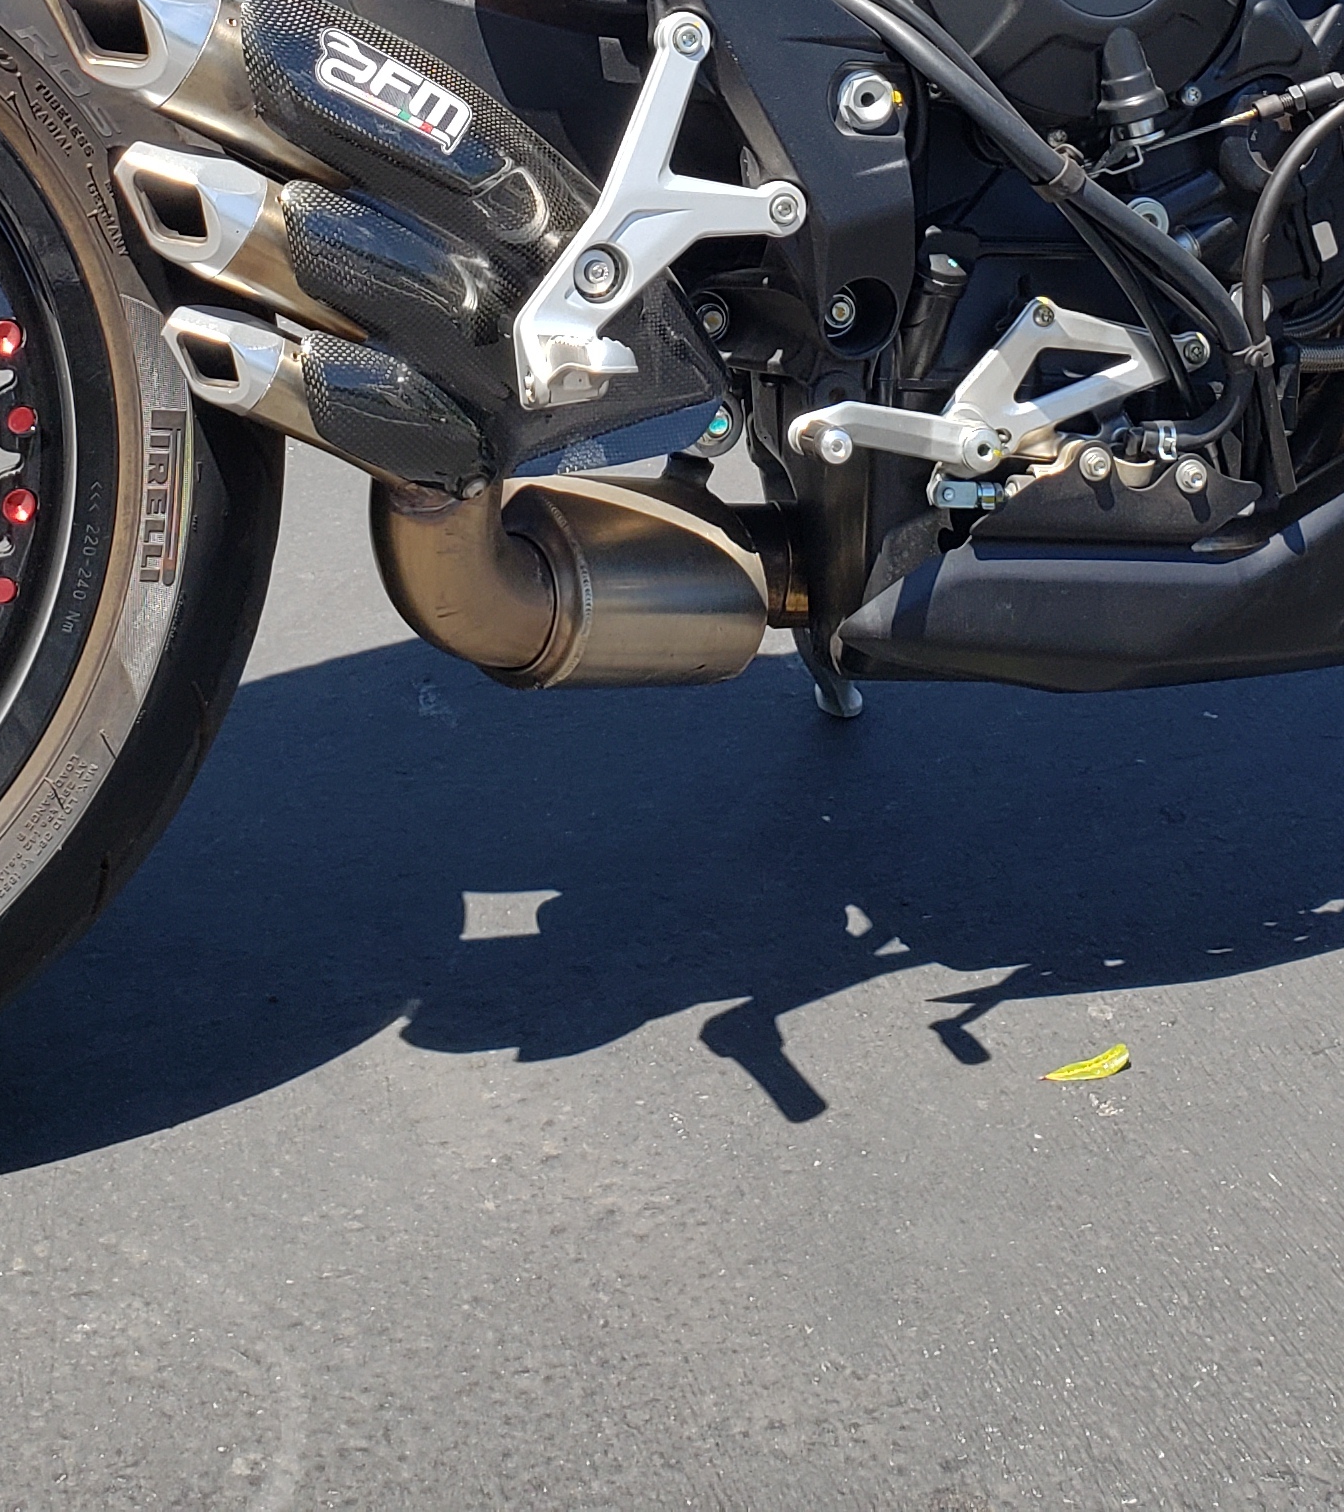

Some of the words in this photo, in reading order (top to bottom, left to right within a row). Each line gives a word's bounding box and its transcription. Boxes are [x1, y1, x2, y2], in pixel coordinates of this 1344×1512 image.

[28, 96, 76, 159] RADIAL
[135, 407, 189, 589] PIRELLI
[70, 522, 100, 602] 220-240
[59, 608, 83, 636] Nm
